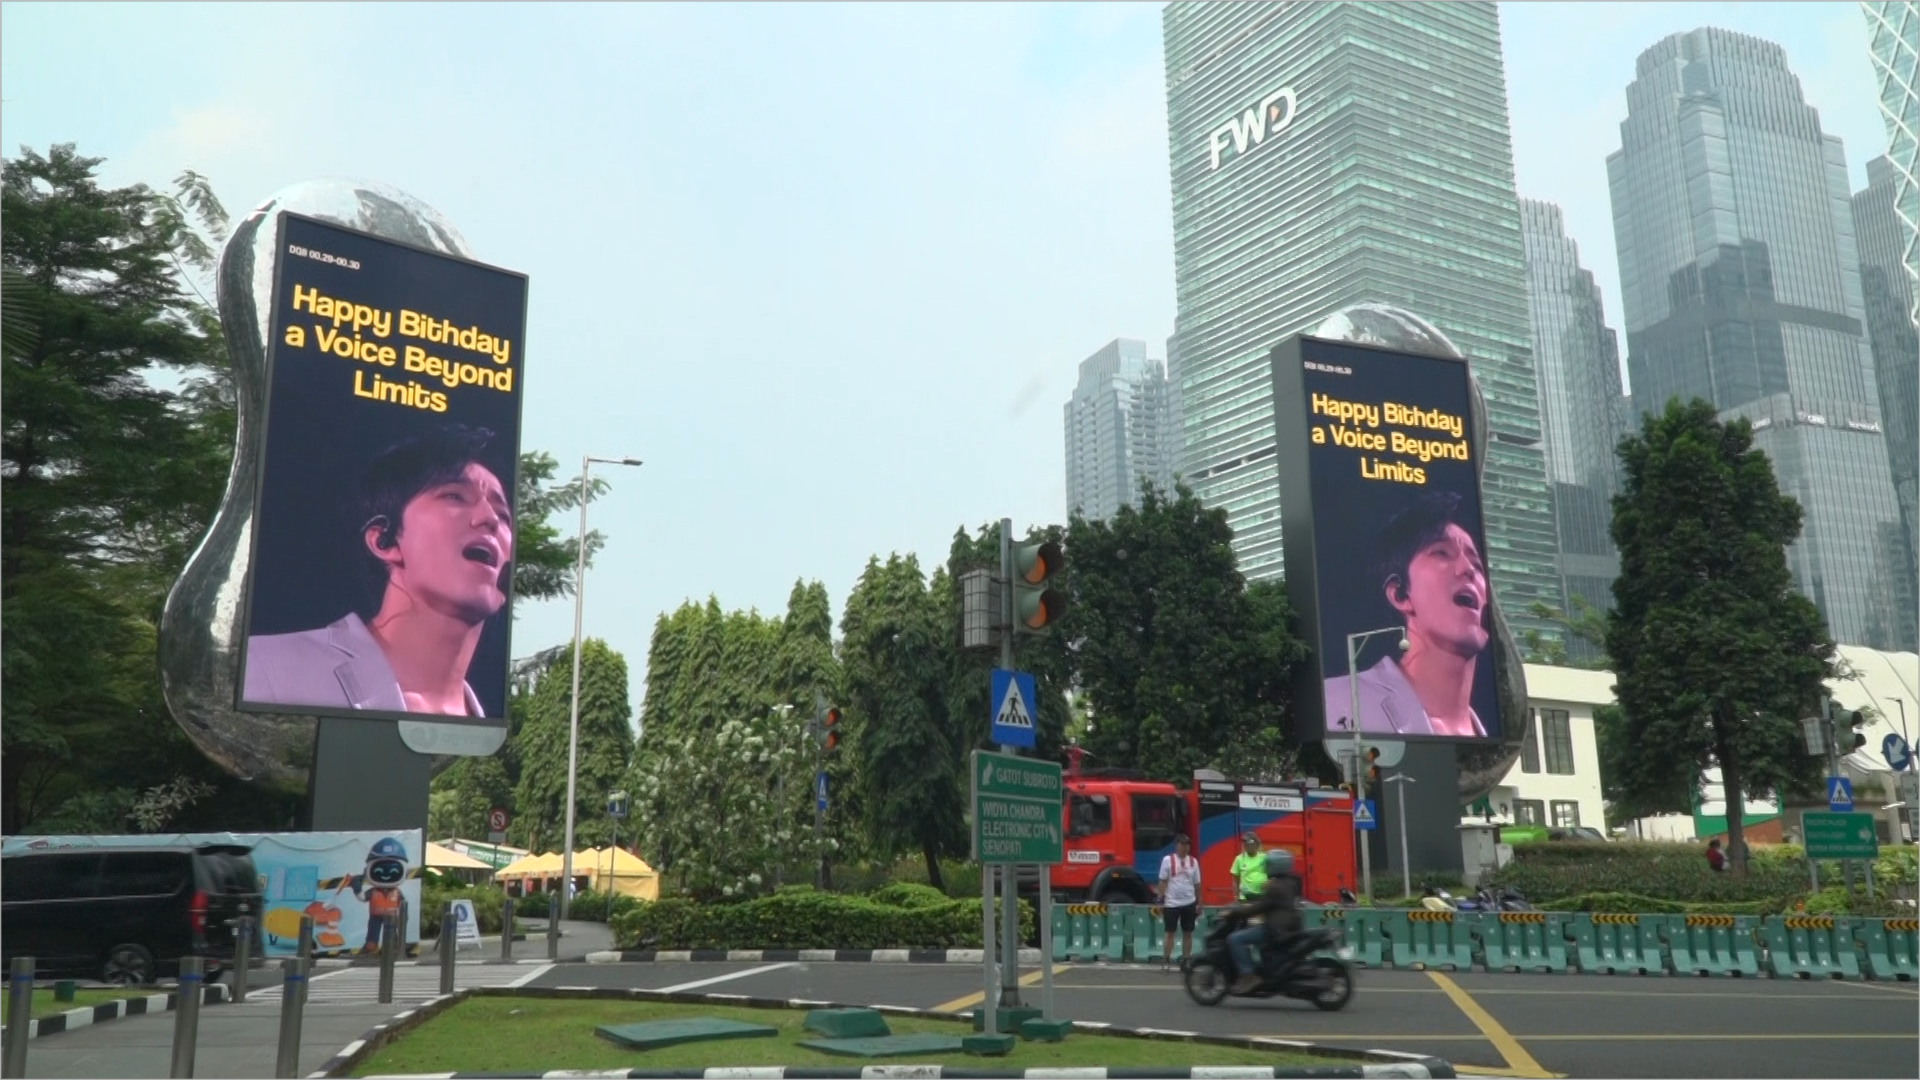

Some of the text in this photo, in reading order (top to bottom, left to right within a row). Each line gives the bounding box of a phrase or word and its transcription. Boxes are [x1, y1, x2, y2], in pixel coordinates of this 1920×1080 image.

[1210, 87, 1297, 170] FWD
[293, 284, 510, 365] Happy Bithday
[284, 325, 513, 392] a Voice Beyond
[354, 370, 448, 413] Limits
[1312, 393, 1464, 438] Happy Bithday
[1312, 424, 1469, 463] a Voice Beyond
[1361, 457, 1427, 485] Limits
[996, 767, 1058, 790] GATOT SUBROTO
[982, 801, 1046, 821] WIDYA CHANDRA
[982, 821, 1049, 840] ELECTRONIC CITY
[982, 839, 1022, 858] SENOPATI
